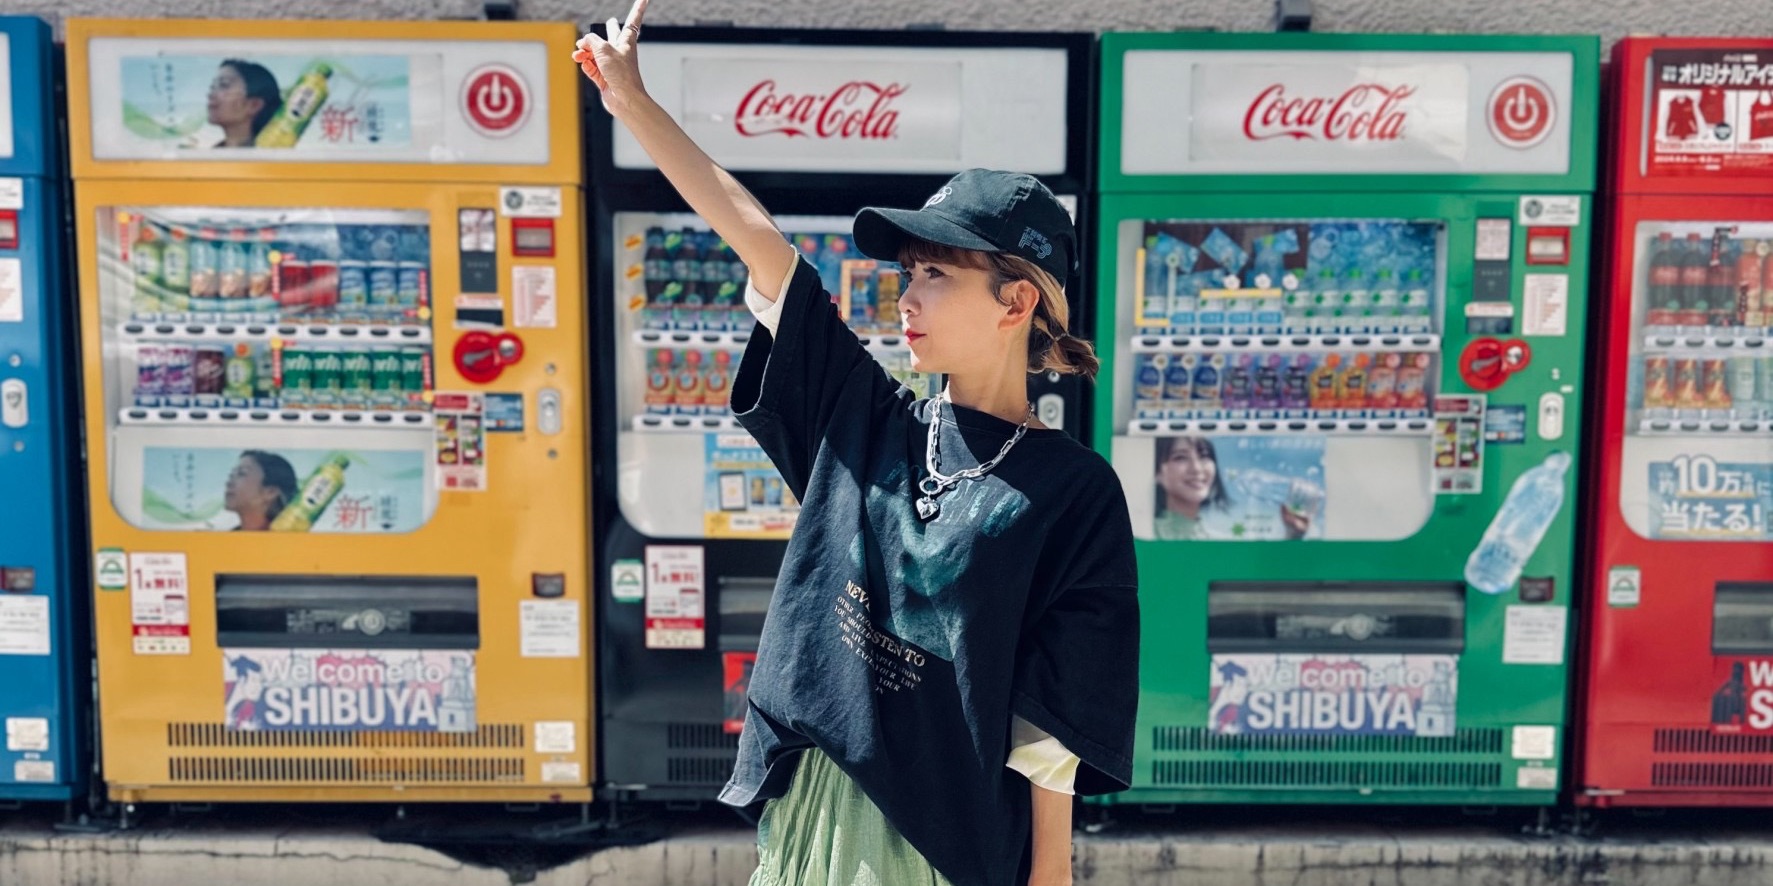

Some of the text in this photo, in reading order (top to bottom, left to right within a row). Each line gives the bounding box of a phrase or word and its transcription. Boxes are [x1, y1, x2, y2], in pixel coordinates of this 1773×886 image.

[320, 104, 358, 143] 新
[735, 79, 911, 139] Coca-Cola
[1242, 84, 1419, 141] Coca-Cola
[333, 494, 373, 530] 新
[834, 604, 847, 618] YOU
[261, 656, 444, 684] Welcome to
[904, 648, 926, 667] TO
[1248, 659, 1426, 688] Welcome to
[879, 676, 901, 692] YOUR
[263, 686, 438, 727] SHIBUYA
[1247, 691, 1417, 731] SHIBUYA
